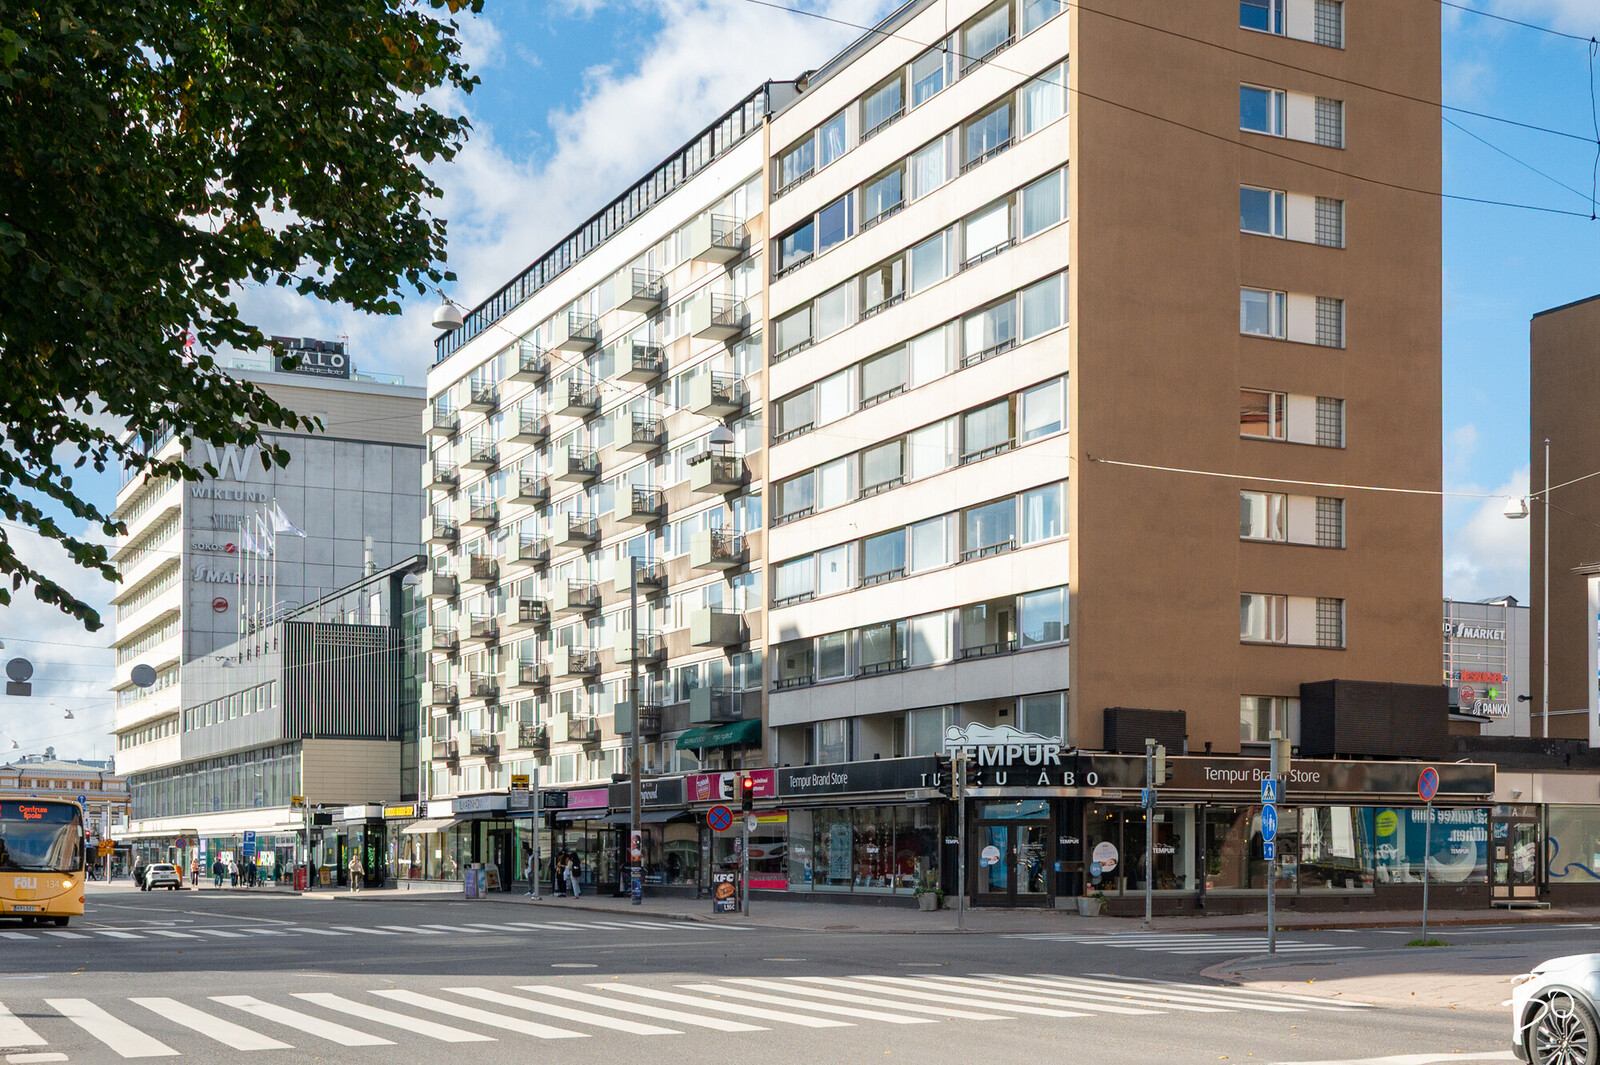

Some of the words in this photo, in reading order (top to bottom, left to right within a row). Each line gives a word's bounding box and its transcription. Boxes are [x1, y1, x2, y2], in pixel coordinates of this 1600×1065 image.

[192, 486, 267, 503] WIKLUND
[192, 542, 223, 553] SOKOS
[1461, 669, 1503, 685] HESBURGER
[1482, 703, 1510, 715] PANKKI
[945, 744, 1061, 767] TEMPUR
[789, 774, 811, 789] Tempur
[812, 772, 831, 786] Brand
[831, 772, 848, 785] Store
[1037, 767, 1099, 786] ÅBO
[1204, 766, 1250, 784] Tempur
[1290, 769, 1320, 783] Store
[1512, 808, 1518, 817] A
[245, 831, 255, 842] P
[14, 876, 37, 889] FÖLI
[47, 880, 60, 889] 134
[713, 873, 735, 883] KFC
